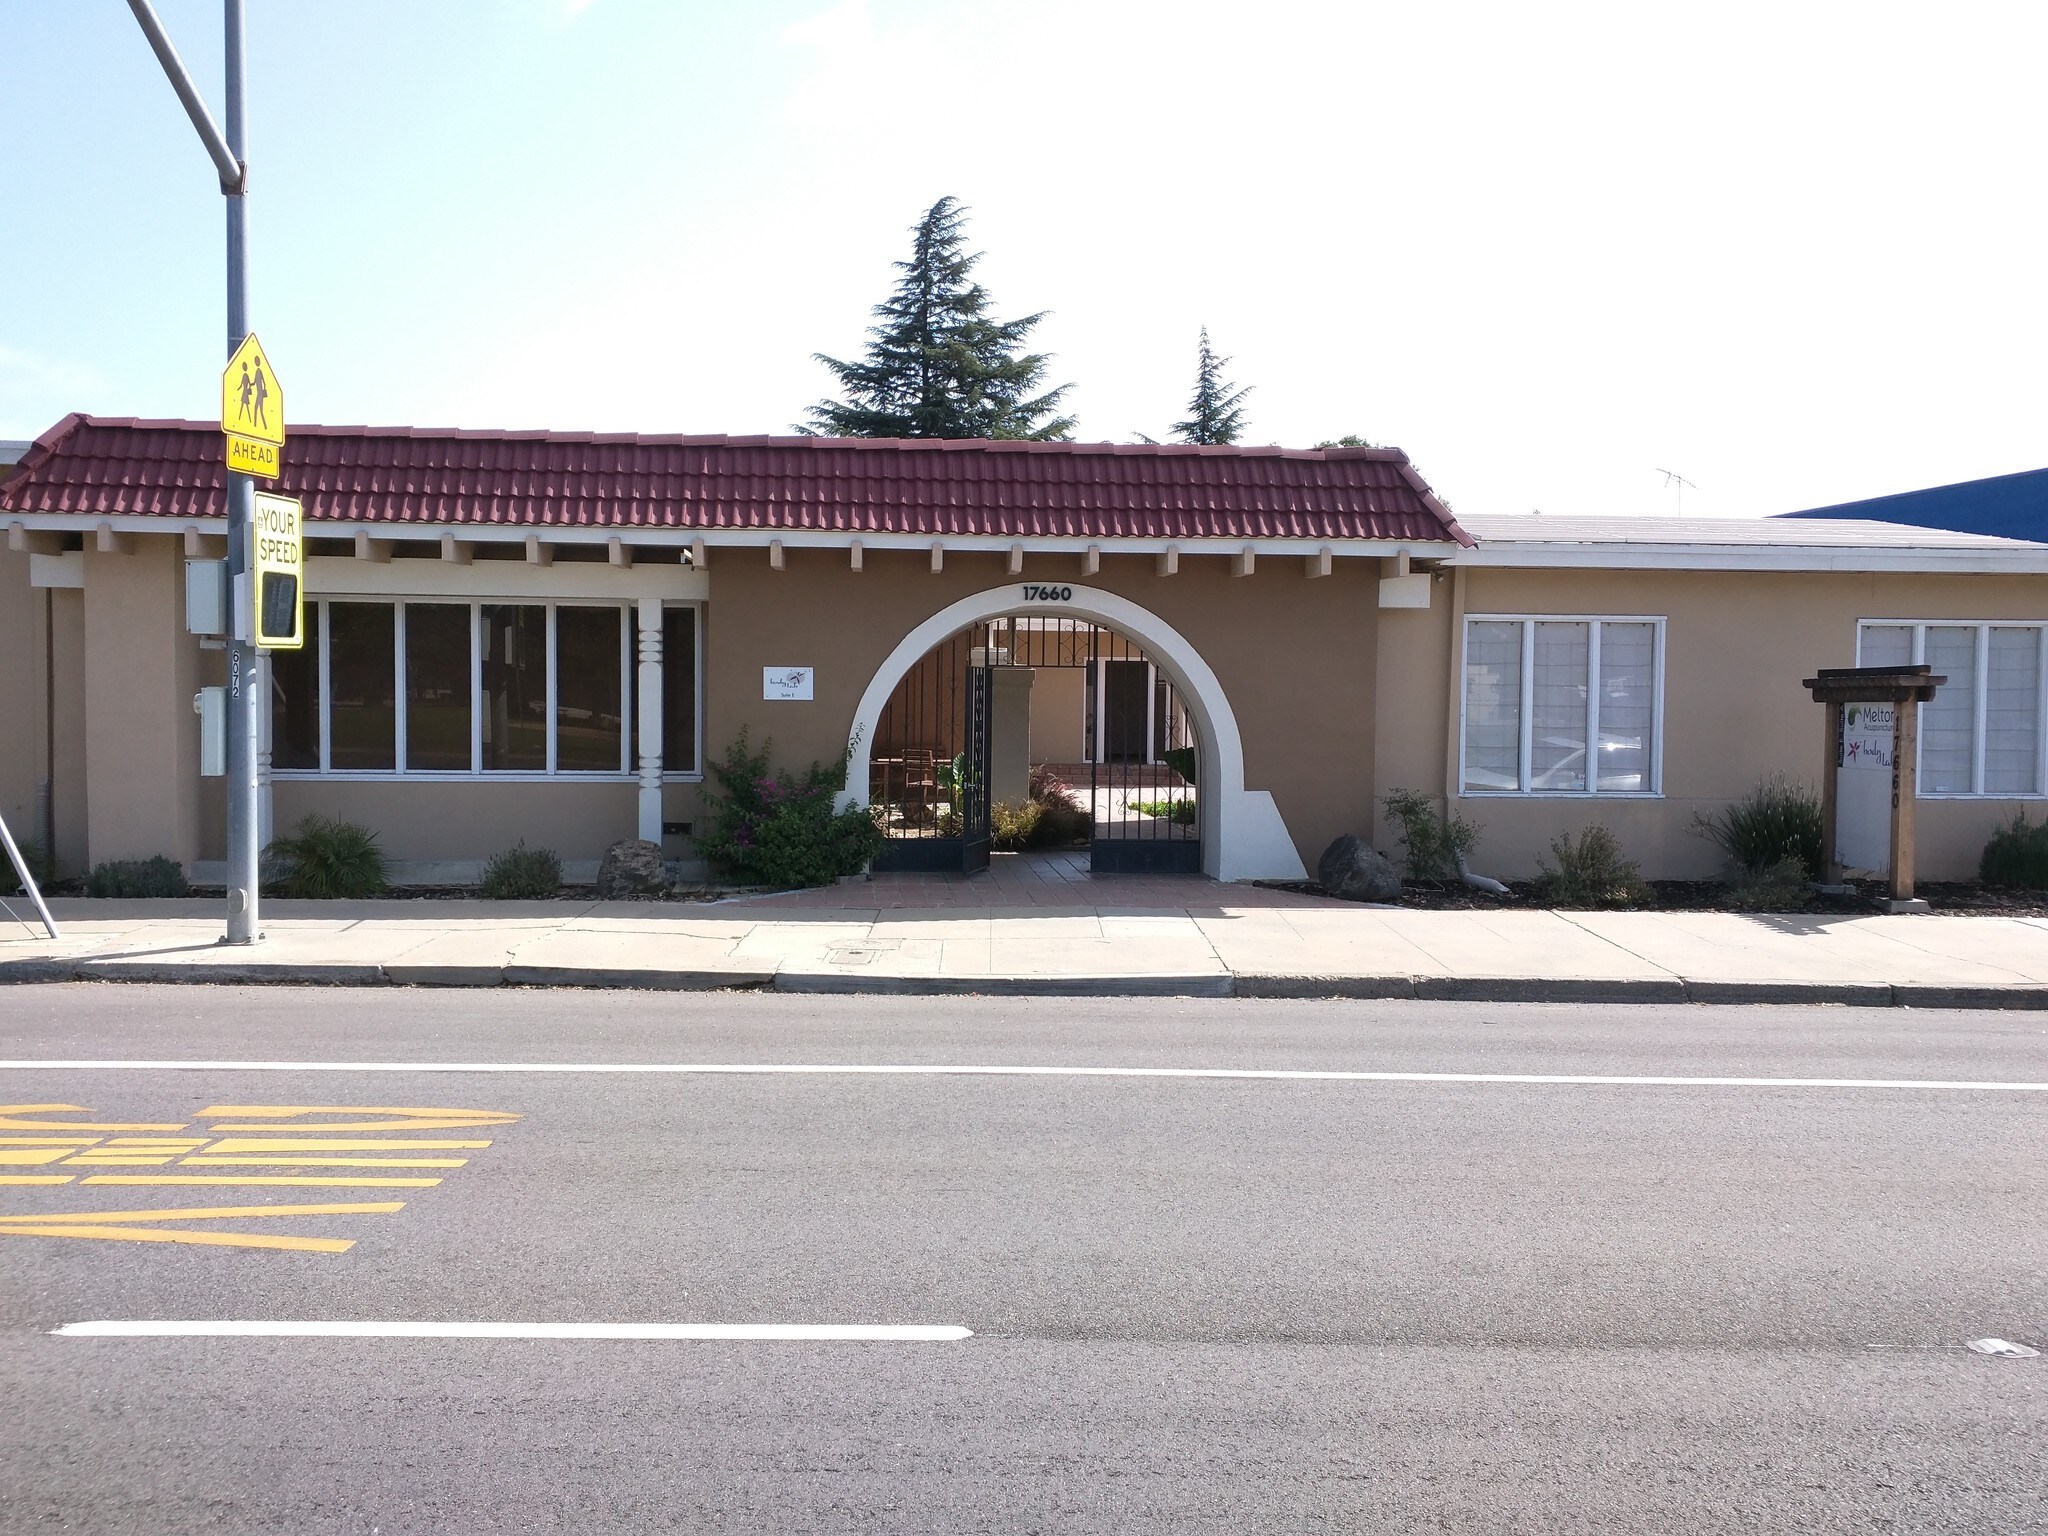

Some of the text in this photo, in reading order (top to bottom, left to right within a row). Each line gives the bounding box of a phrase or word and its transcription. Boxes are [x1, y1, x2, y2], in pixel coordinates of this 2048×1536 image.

[233, 441, 273, 464] AHEAD
[261, 508, 295, 536] YOUR
[260, 537, 298, 564] SPEED
[1023, 586, 1072, 601] 17660
[1891, 715, 1900, 809] 17660
